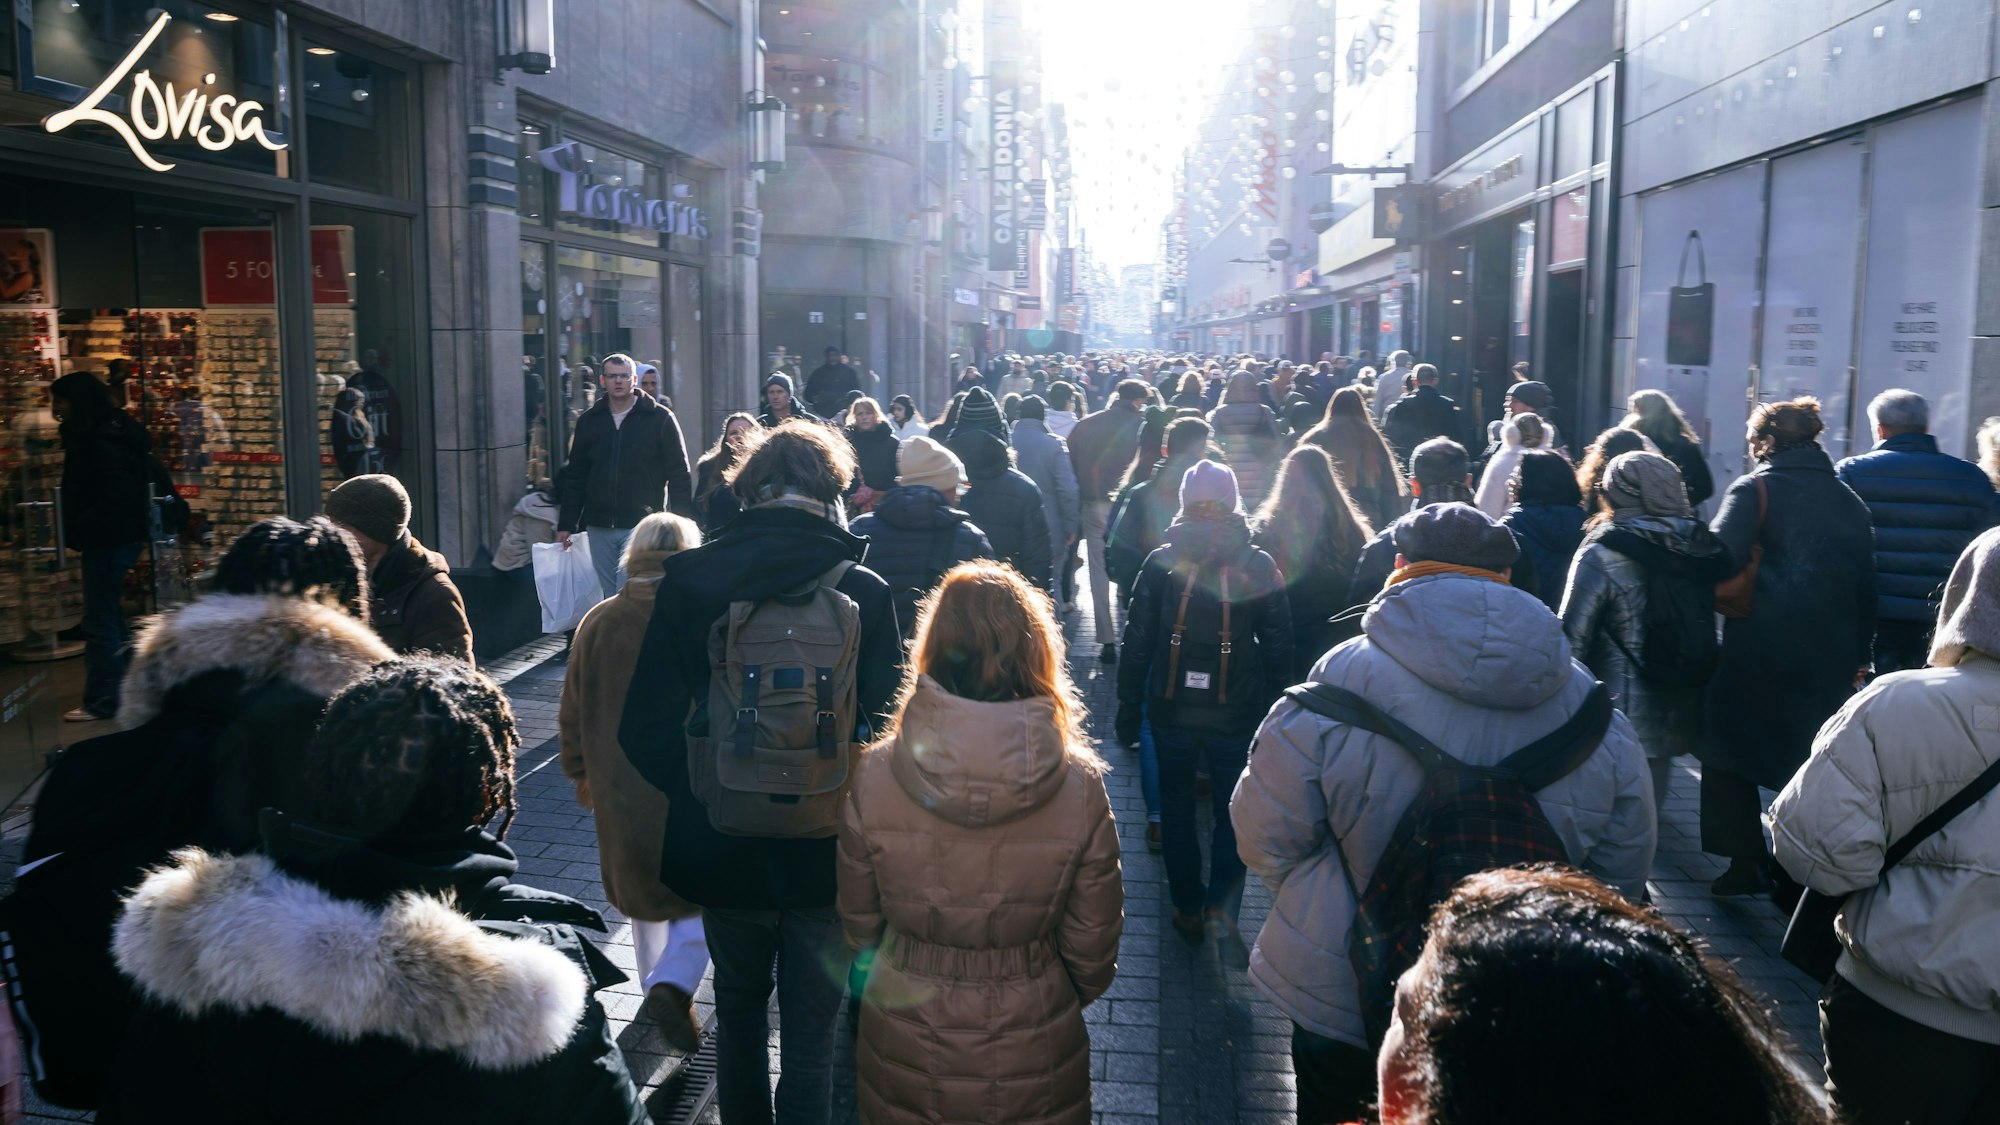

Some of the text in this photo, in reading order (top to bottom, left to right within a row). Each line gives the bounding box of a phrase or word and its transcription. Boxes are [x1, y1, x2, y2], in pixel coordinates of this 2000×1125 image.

[994, 90, 1013, 244] CALZEDONIA
[226, 261, 272, 278] 5 FO
